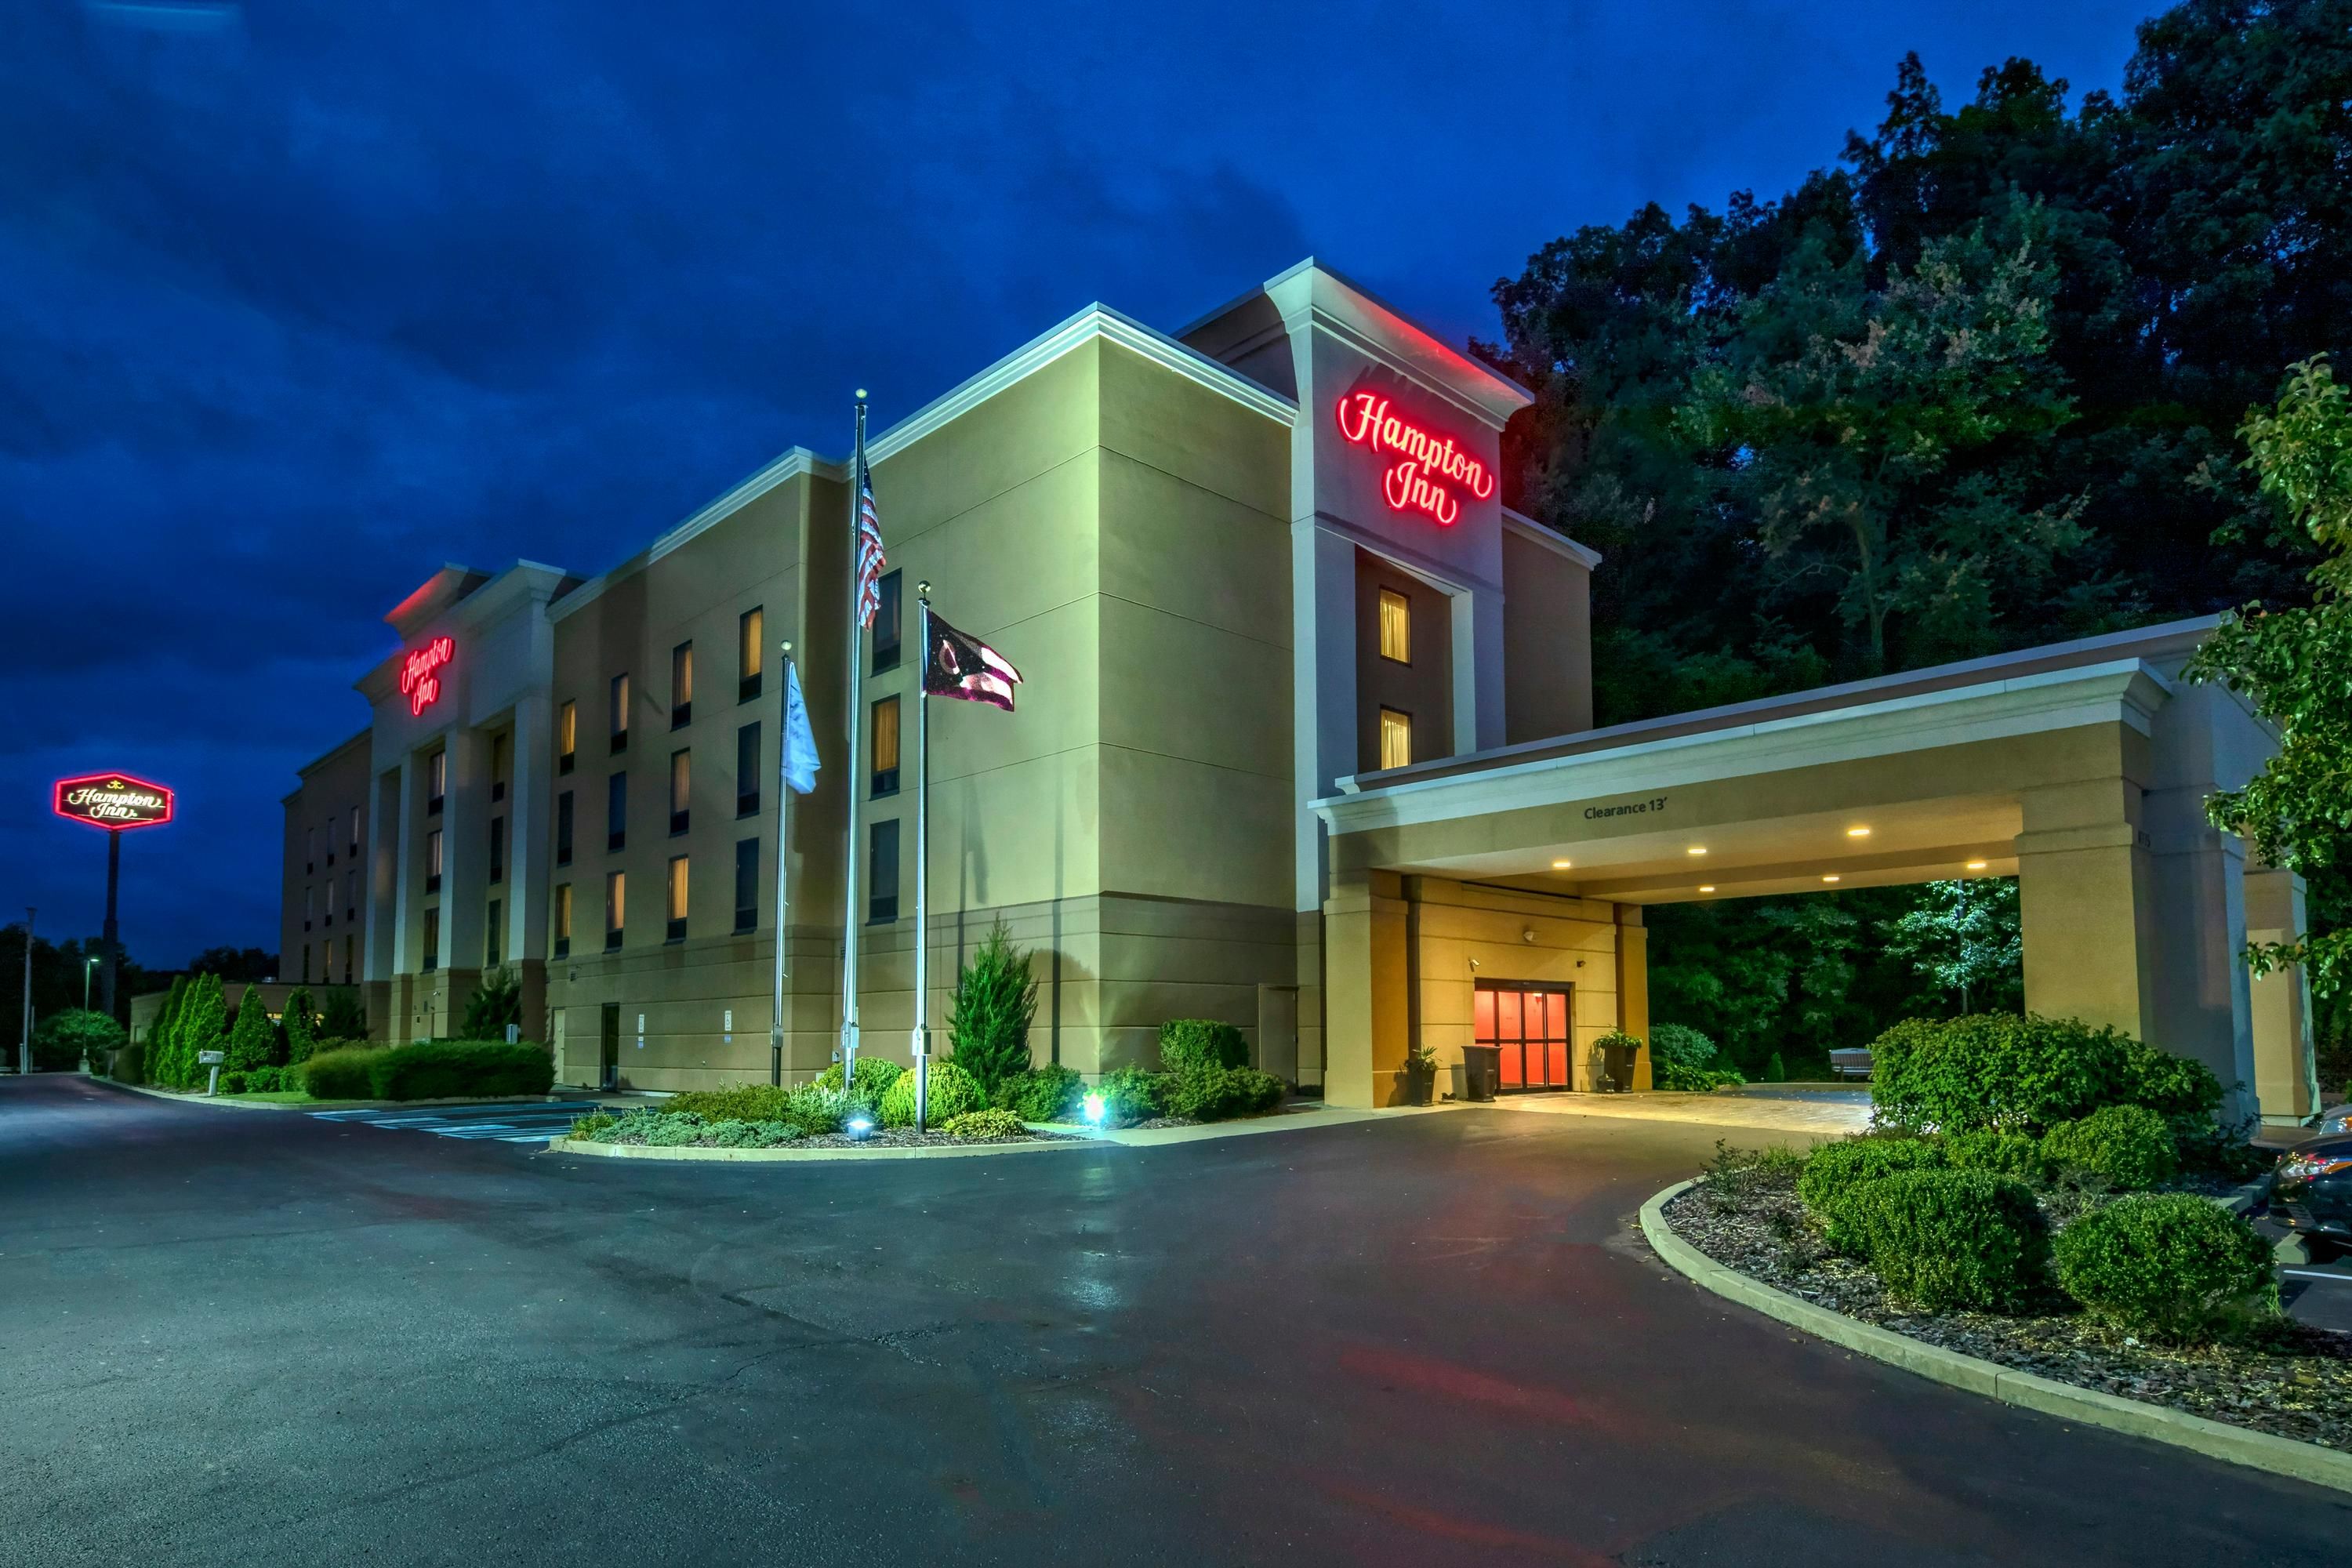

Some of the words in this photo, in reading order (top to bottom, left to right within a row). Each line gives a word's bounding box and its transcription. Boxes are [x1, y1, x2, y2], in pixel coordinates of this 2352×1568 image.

[1338, 393, 1494, 499] Hampton
[1384, 460, 1458, 525] Inn
[401, 637, 453, 695] Hampton
[412, 676, 438, 716] Inn
[67, 789, 162, 808] Hampton
[89, 803, 135, 818] Inn
[1584, 803, 1646, 819] Clearance
[1649, 796, 1668, 811] 13'
